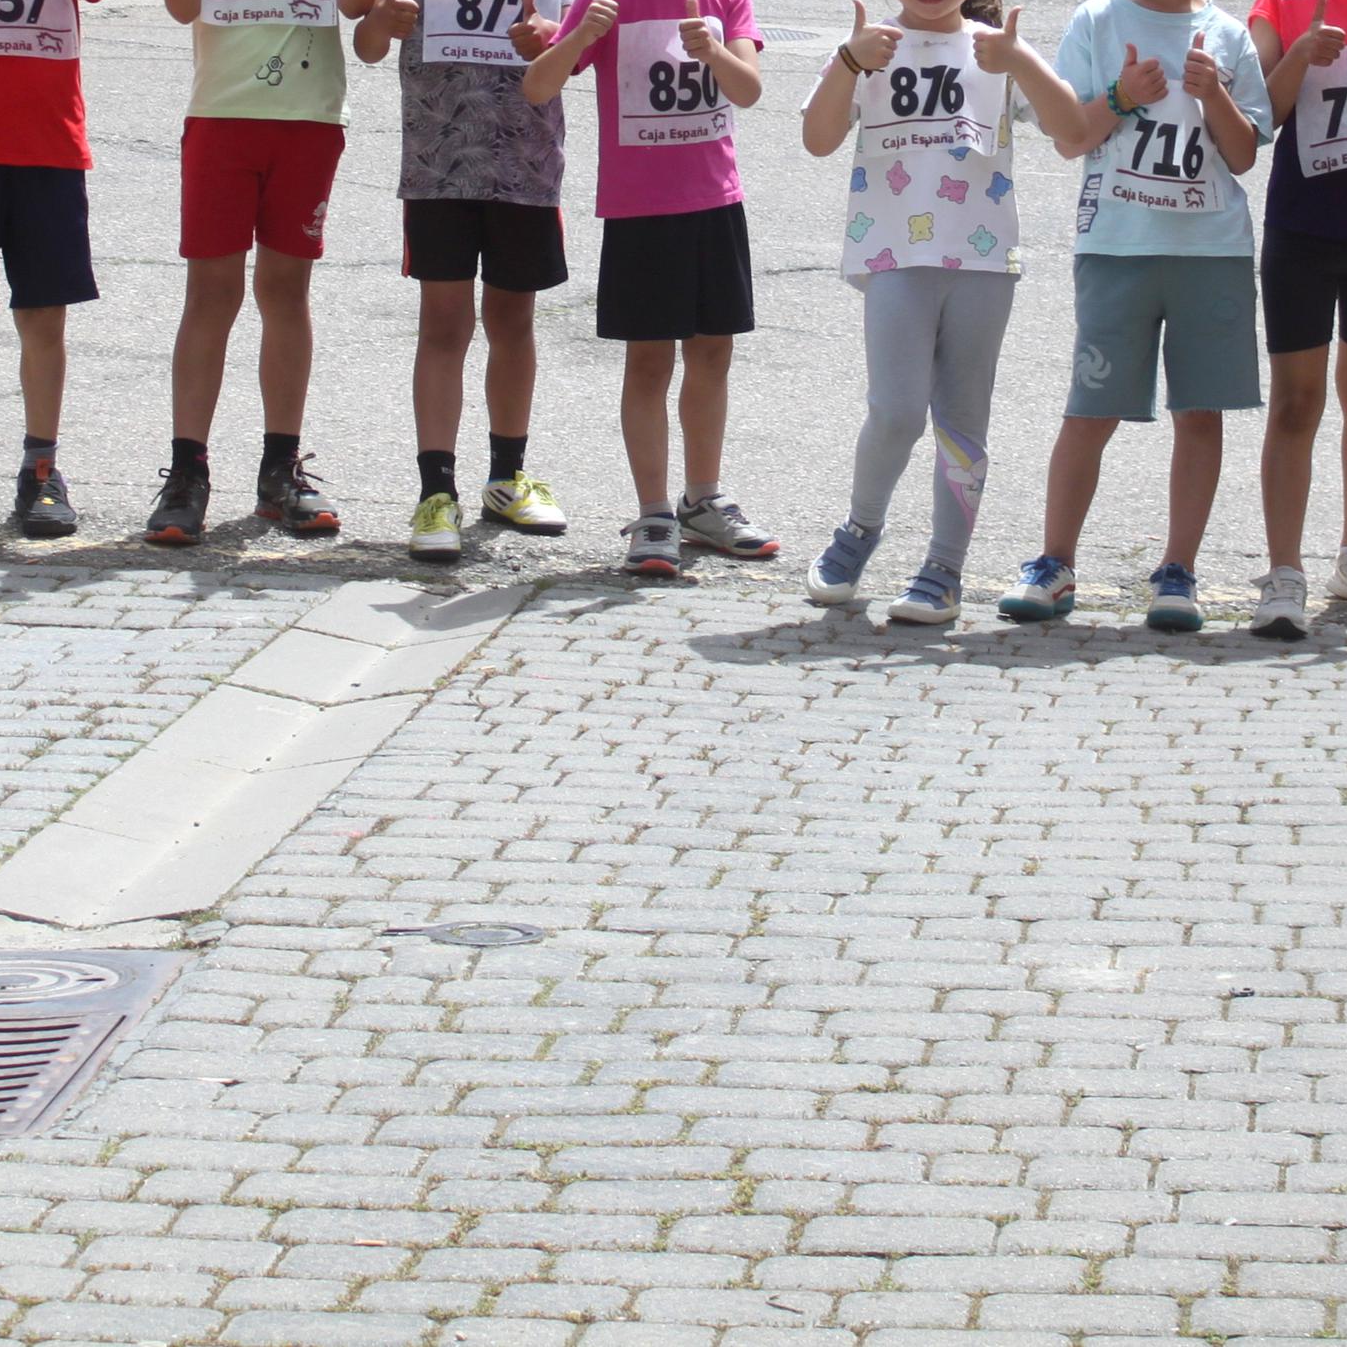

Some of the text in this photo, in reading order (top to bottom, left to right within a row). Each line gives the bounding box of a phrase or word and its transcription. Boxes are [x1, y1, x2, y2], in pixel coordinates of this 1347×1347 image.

[213, 7, 285, 24] Caja España
[441, 46, 513, 61] Caja España
[648, 60, 719, 112] 850
[890, 64, 965, 117] 876
[638, 127, 709, 144] Caja España
[882, 132, 955, 150] Caja España
[1131, 117, 1205, 180] 716
[1312, 156, 1338, 172] Caja
[1112, 184, 1178, 209] Caja España
